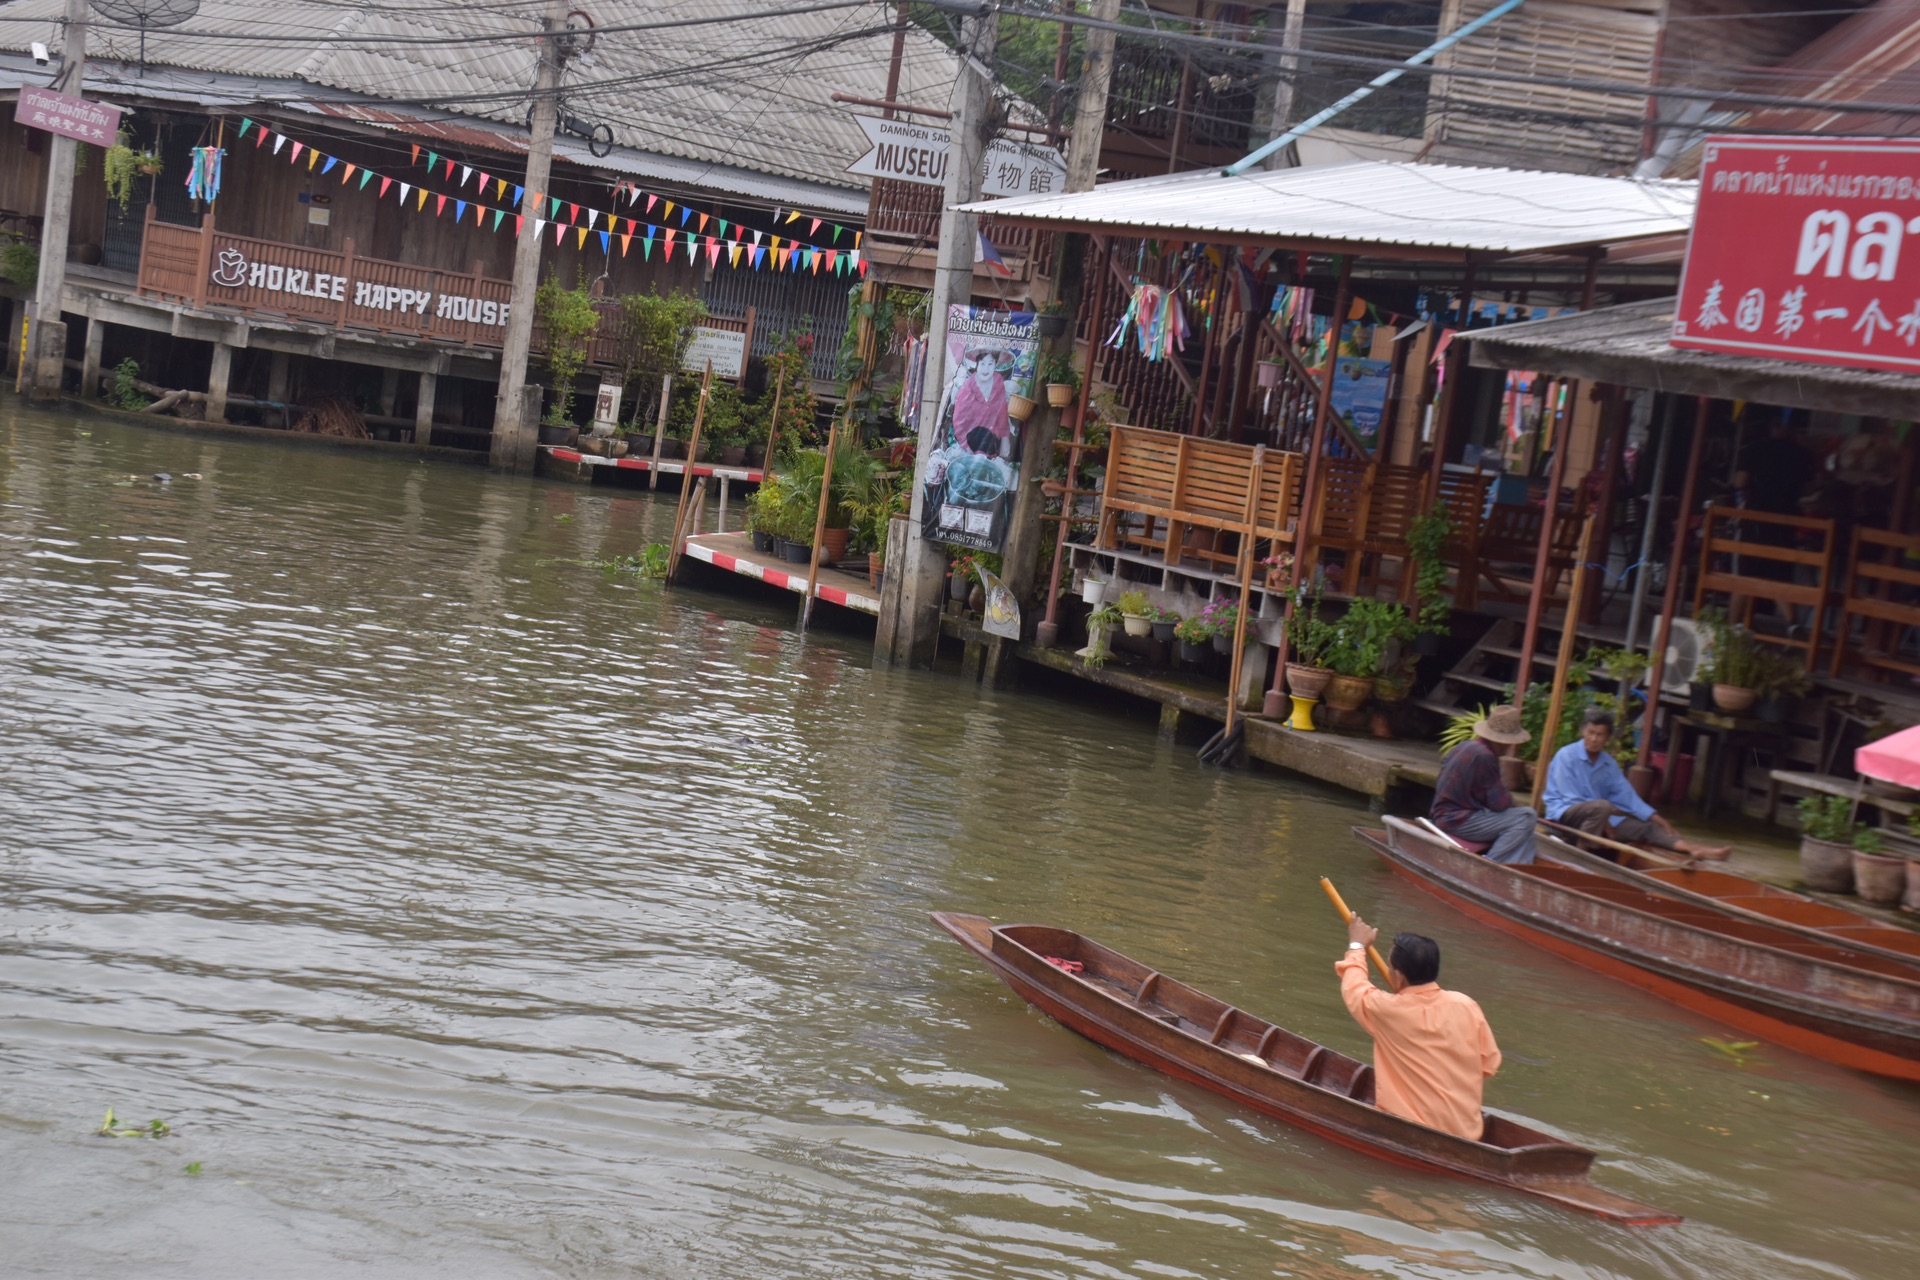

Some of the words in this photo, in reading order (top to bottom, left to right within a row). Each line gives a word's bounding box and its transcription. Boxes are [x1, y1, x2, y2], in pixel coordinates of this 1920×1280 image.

[880, 123, 928, 140] DAMNOEN
[931, 132, 950, 143] SAD
[985, 142, 1016, 154] ATING
[1019, 146, 1056, 160] MARKET
[248, 262, 348, 301] HOKLEE
[354, 281, 431, 314] HAPPY
[436, 293, 510, 326] HOUSE
